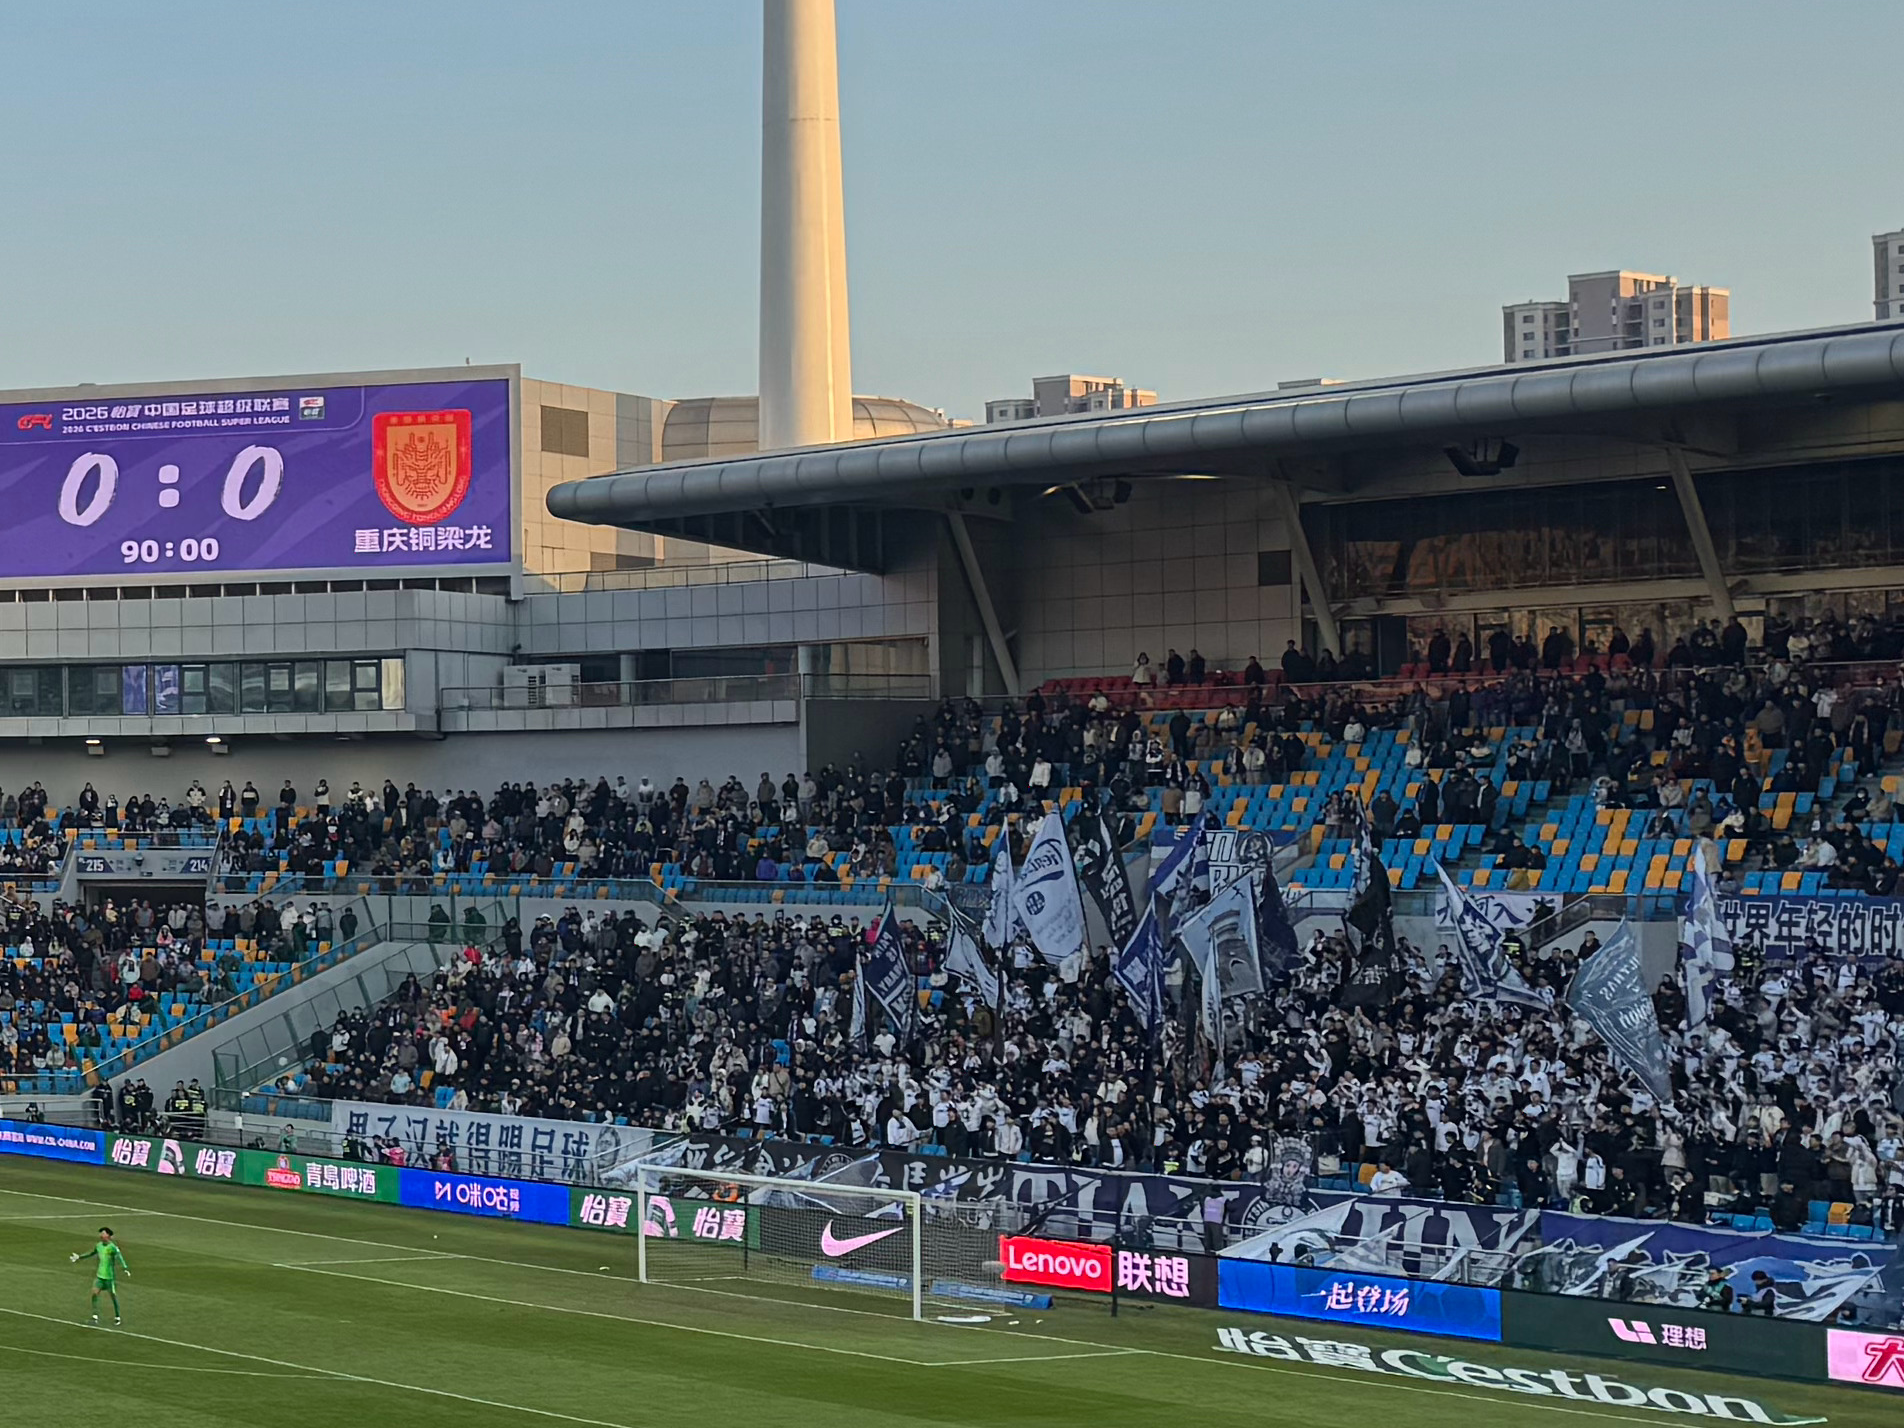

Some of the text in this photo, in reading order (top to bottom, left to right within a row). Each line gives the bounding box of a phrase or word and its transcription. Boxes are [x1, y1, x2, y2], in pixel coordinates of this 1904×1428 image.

[62, 406, 108, 420] 2026
[144, 397, 289, 417] 中国足球超级联赛
[131, 420, 170, 430] CHINESE
[171, 418, 219, 429] FOOTBALL
[221, 417, 251, 427] SUPER
[253, 415, 290, 425] LEAGUE
[58, 452, 119, 526] 0
[221, 445, 284, 520] 0
[121, 538, 219, 564] 90:00
[354, 524, 493, 553] 重庆铜梁龙
[86, 858, 104, 871] 215
[190, 859, 208, 871] 214
[1008, 1247, 1190, 1298] Lenovo 联想
[1301, 1280, 1409, 1317] 一起登场
[1661, 1323, 1707, 1350] 理想
